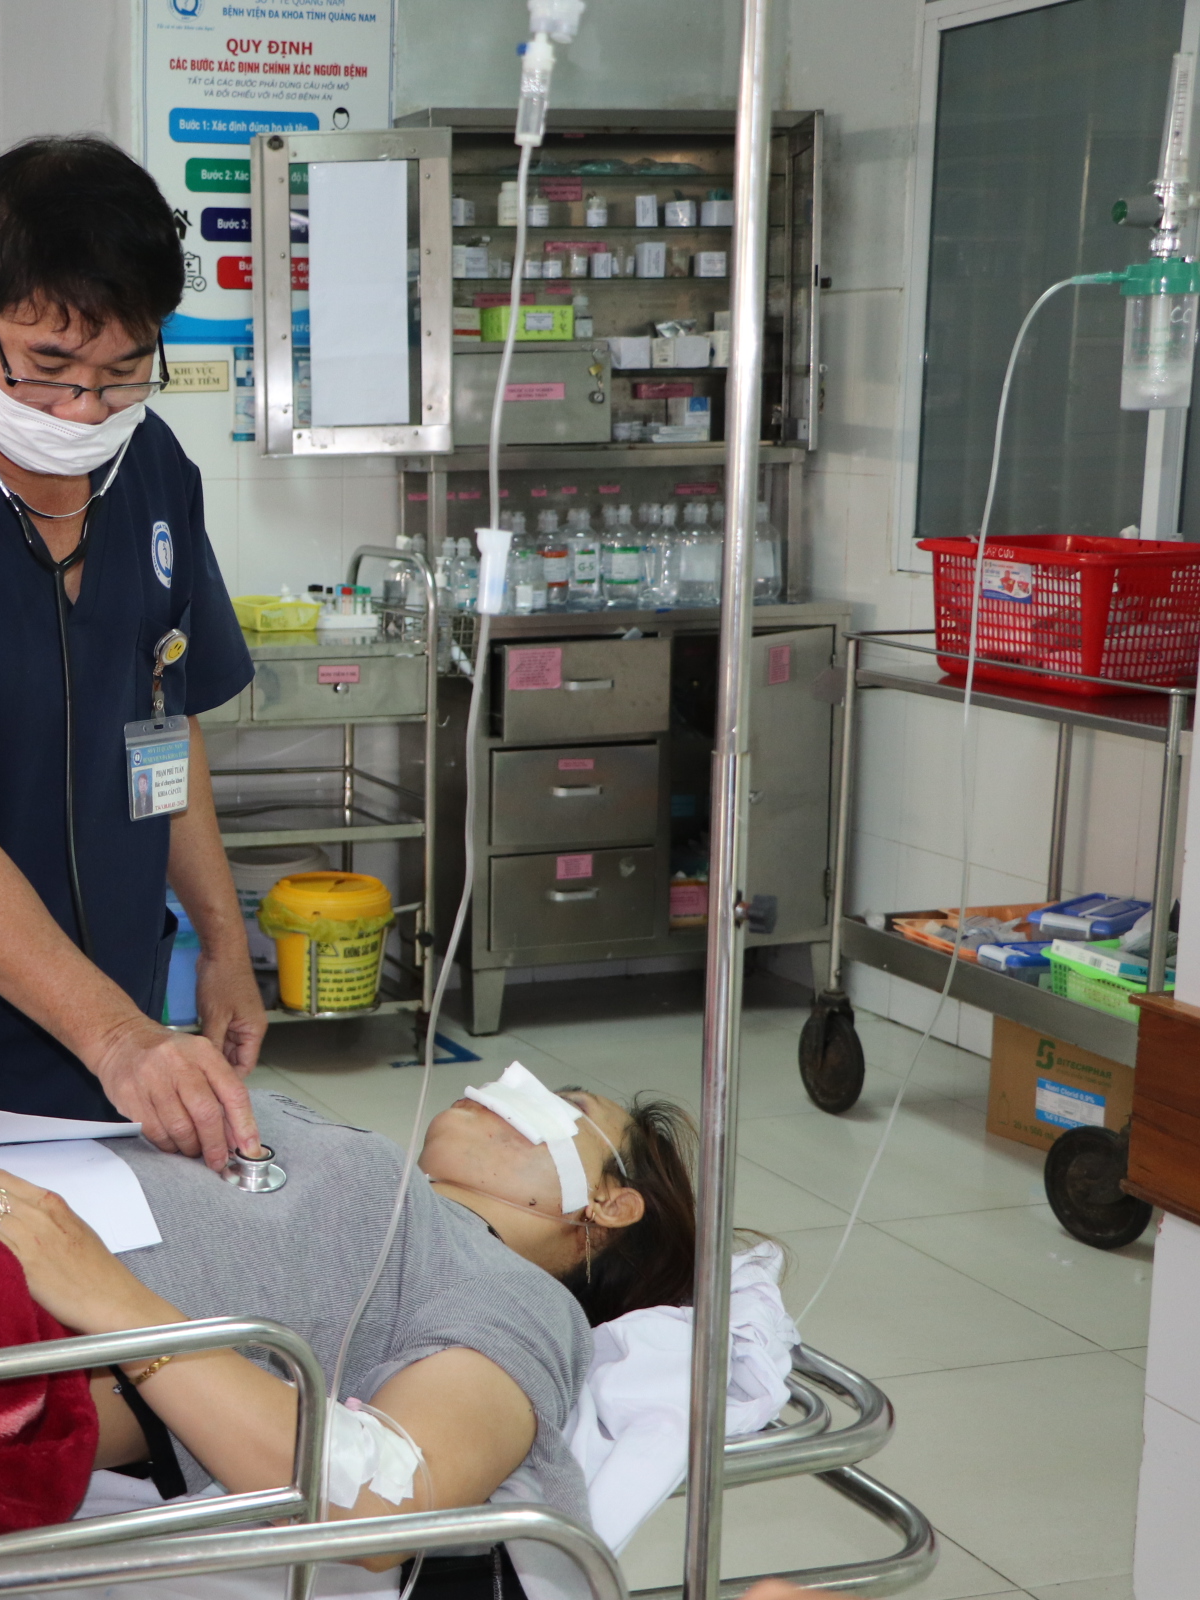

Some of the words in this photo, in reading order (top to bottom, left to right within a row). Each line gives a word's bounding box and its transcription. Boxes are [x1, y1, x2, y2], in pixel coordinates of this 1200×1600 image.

[223, 5, 244, 18] BỆNH
[246, 6, 266, 19] VIỆN
[268, 9, 279, 18] ĐA
[282, 10, 303, 19] KHOA
[306, 8, 325, 20] TỈNH
[328, 9, 356, 22] QUẢNG
[359, 14, 376, 22] NAM
[226, 38, 262, 56] QUY
[267, 40, 312, 58] ĐỊNH
[169, 57, 188, 71] CÁC
[190, 57, 214, 72] BƯỚC
[217, 59, 235, 73] XÁC
[238, 62, 260, 75] ĐỊNH
[262, 61, 290, 75] CHÍNH
[292, 61, 311, 75] XÁC
[314, 62, 341, 76] NGƯỜI
[343, 63, 368, 79] BỆNH
[179, 118, 200, 130] Bước
[202, 122, 210, 130] 1:
[212, 121, 227, 131] Xác
[228, 121, 247, 133] định
[248, 122, 269, 133] đúng
[201, 168, 223, 181] Bước
[225, 170, 232, 181] 2:
[234, 170, 250, 181] Xác
[217, 218, 239, 230] Bước
[241, 219, 249, 230] 3:
[174, 367, 193, 375] KHU
[195, 366, 215, 376] VỰC
